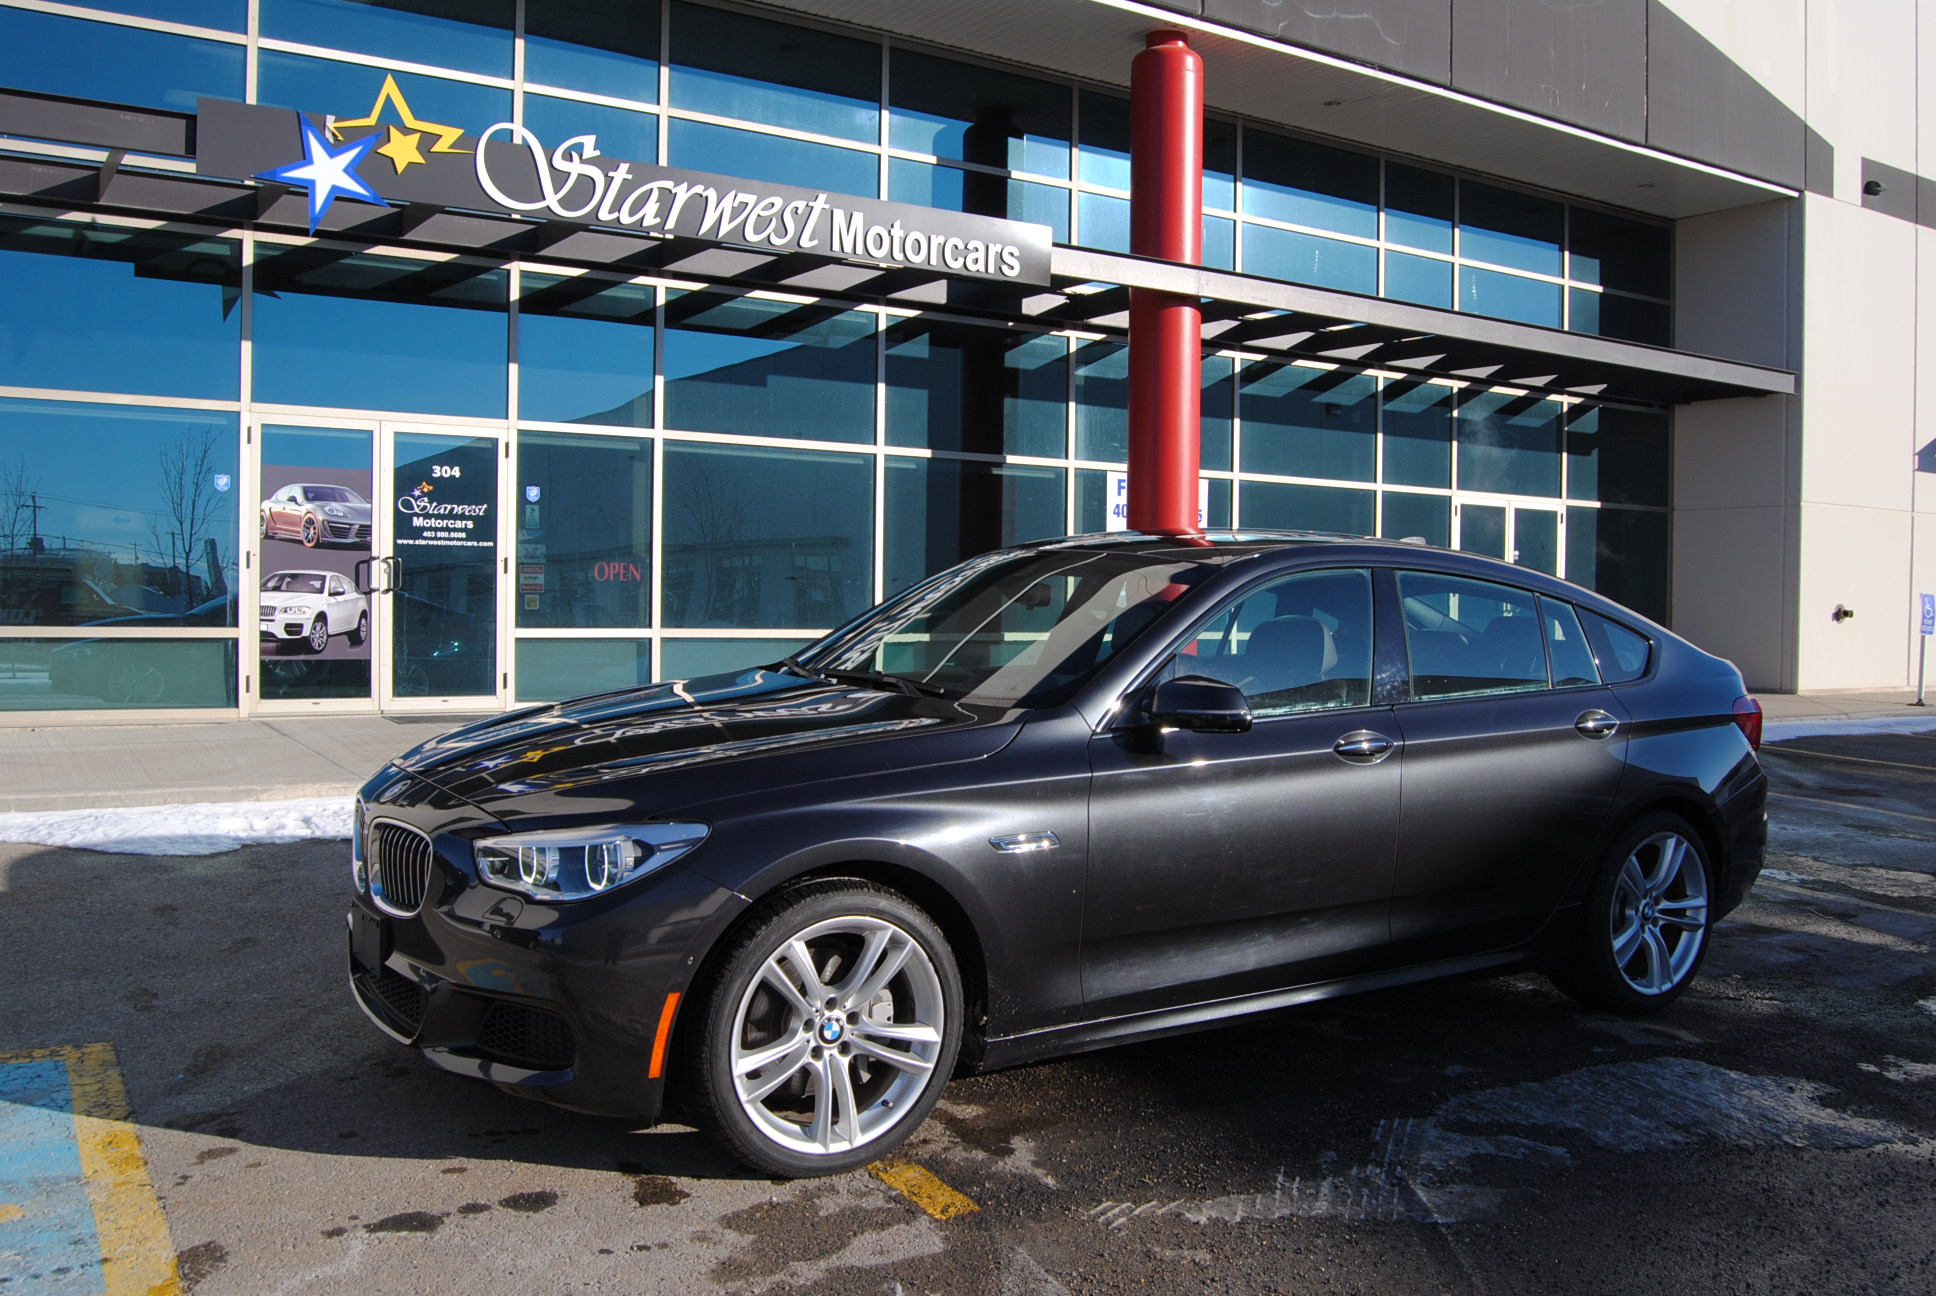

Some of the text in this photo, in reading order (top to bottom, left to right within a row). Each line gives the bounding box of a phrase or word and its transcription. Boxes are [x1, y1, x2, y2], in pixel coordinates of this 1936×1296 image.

[476, 122, 1020, 277] Starwest Motorcars
[432, 465, 461, 478] 304
[398, 496, 488, 516] Starwest
[412, 516, 474, 529] Motorcars
[396, 538, 494, 547] www.starwestmotorcars.com
[594, 561, 641, 582] OPEN
